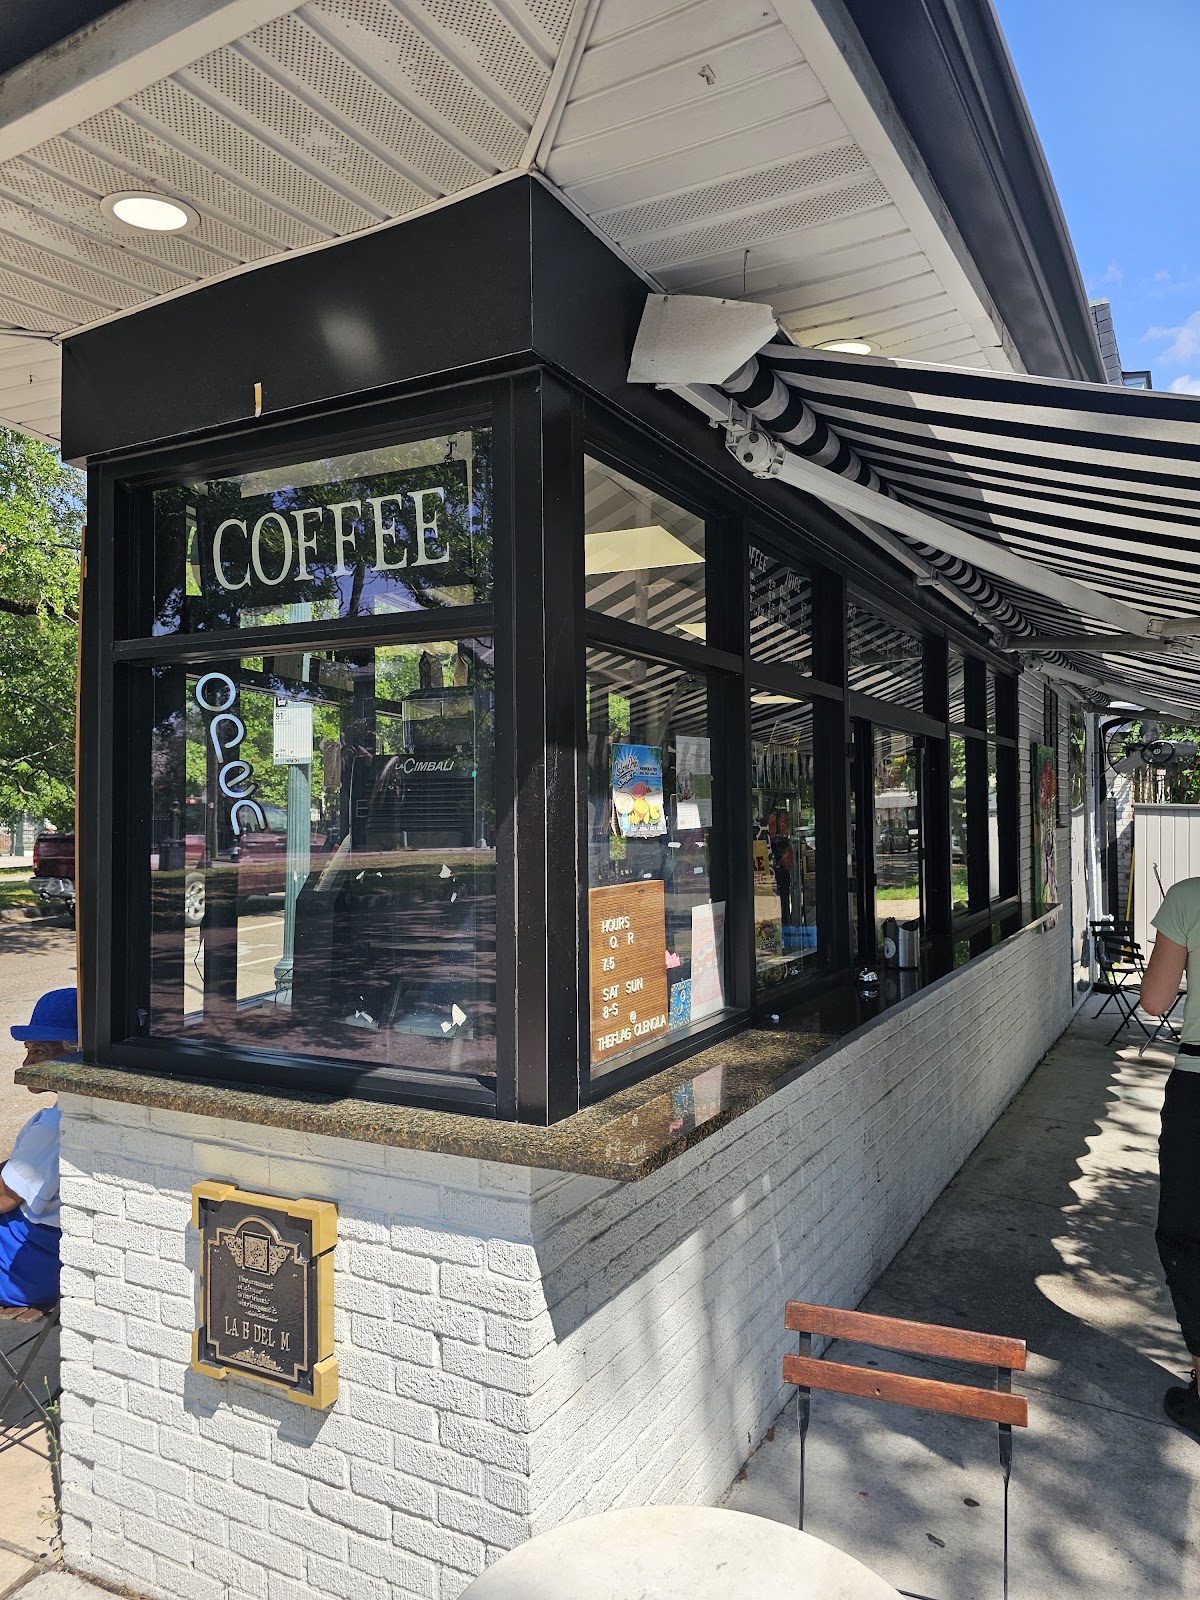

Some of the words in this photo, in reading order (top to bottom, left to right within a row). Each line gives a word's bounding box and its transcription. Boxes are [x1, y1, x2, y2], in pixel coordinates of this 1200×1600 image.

[213, 487, 450, 591] COFFEE
[404, 757, 455, 774] CIMBALI
[601, 916, 630, 933] HOURS
[627, 932, 635, 945] R
[602, 984, 620, 1001] SAT
[625, 977, 644, 994] SUN
[225, 1316, 239, 1337] LA
[242, 1321, 250, 1340] B
[253, 1324, 276, 1347] DEL
[280, 1331, 291, 1352] M
